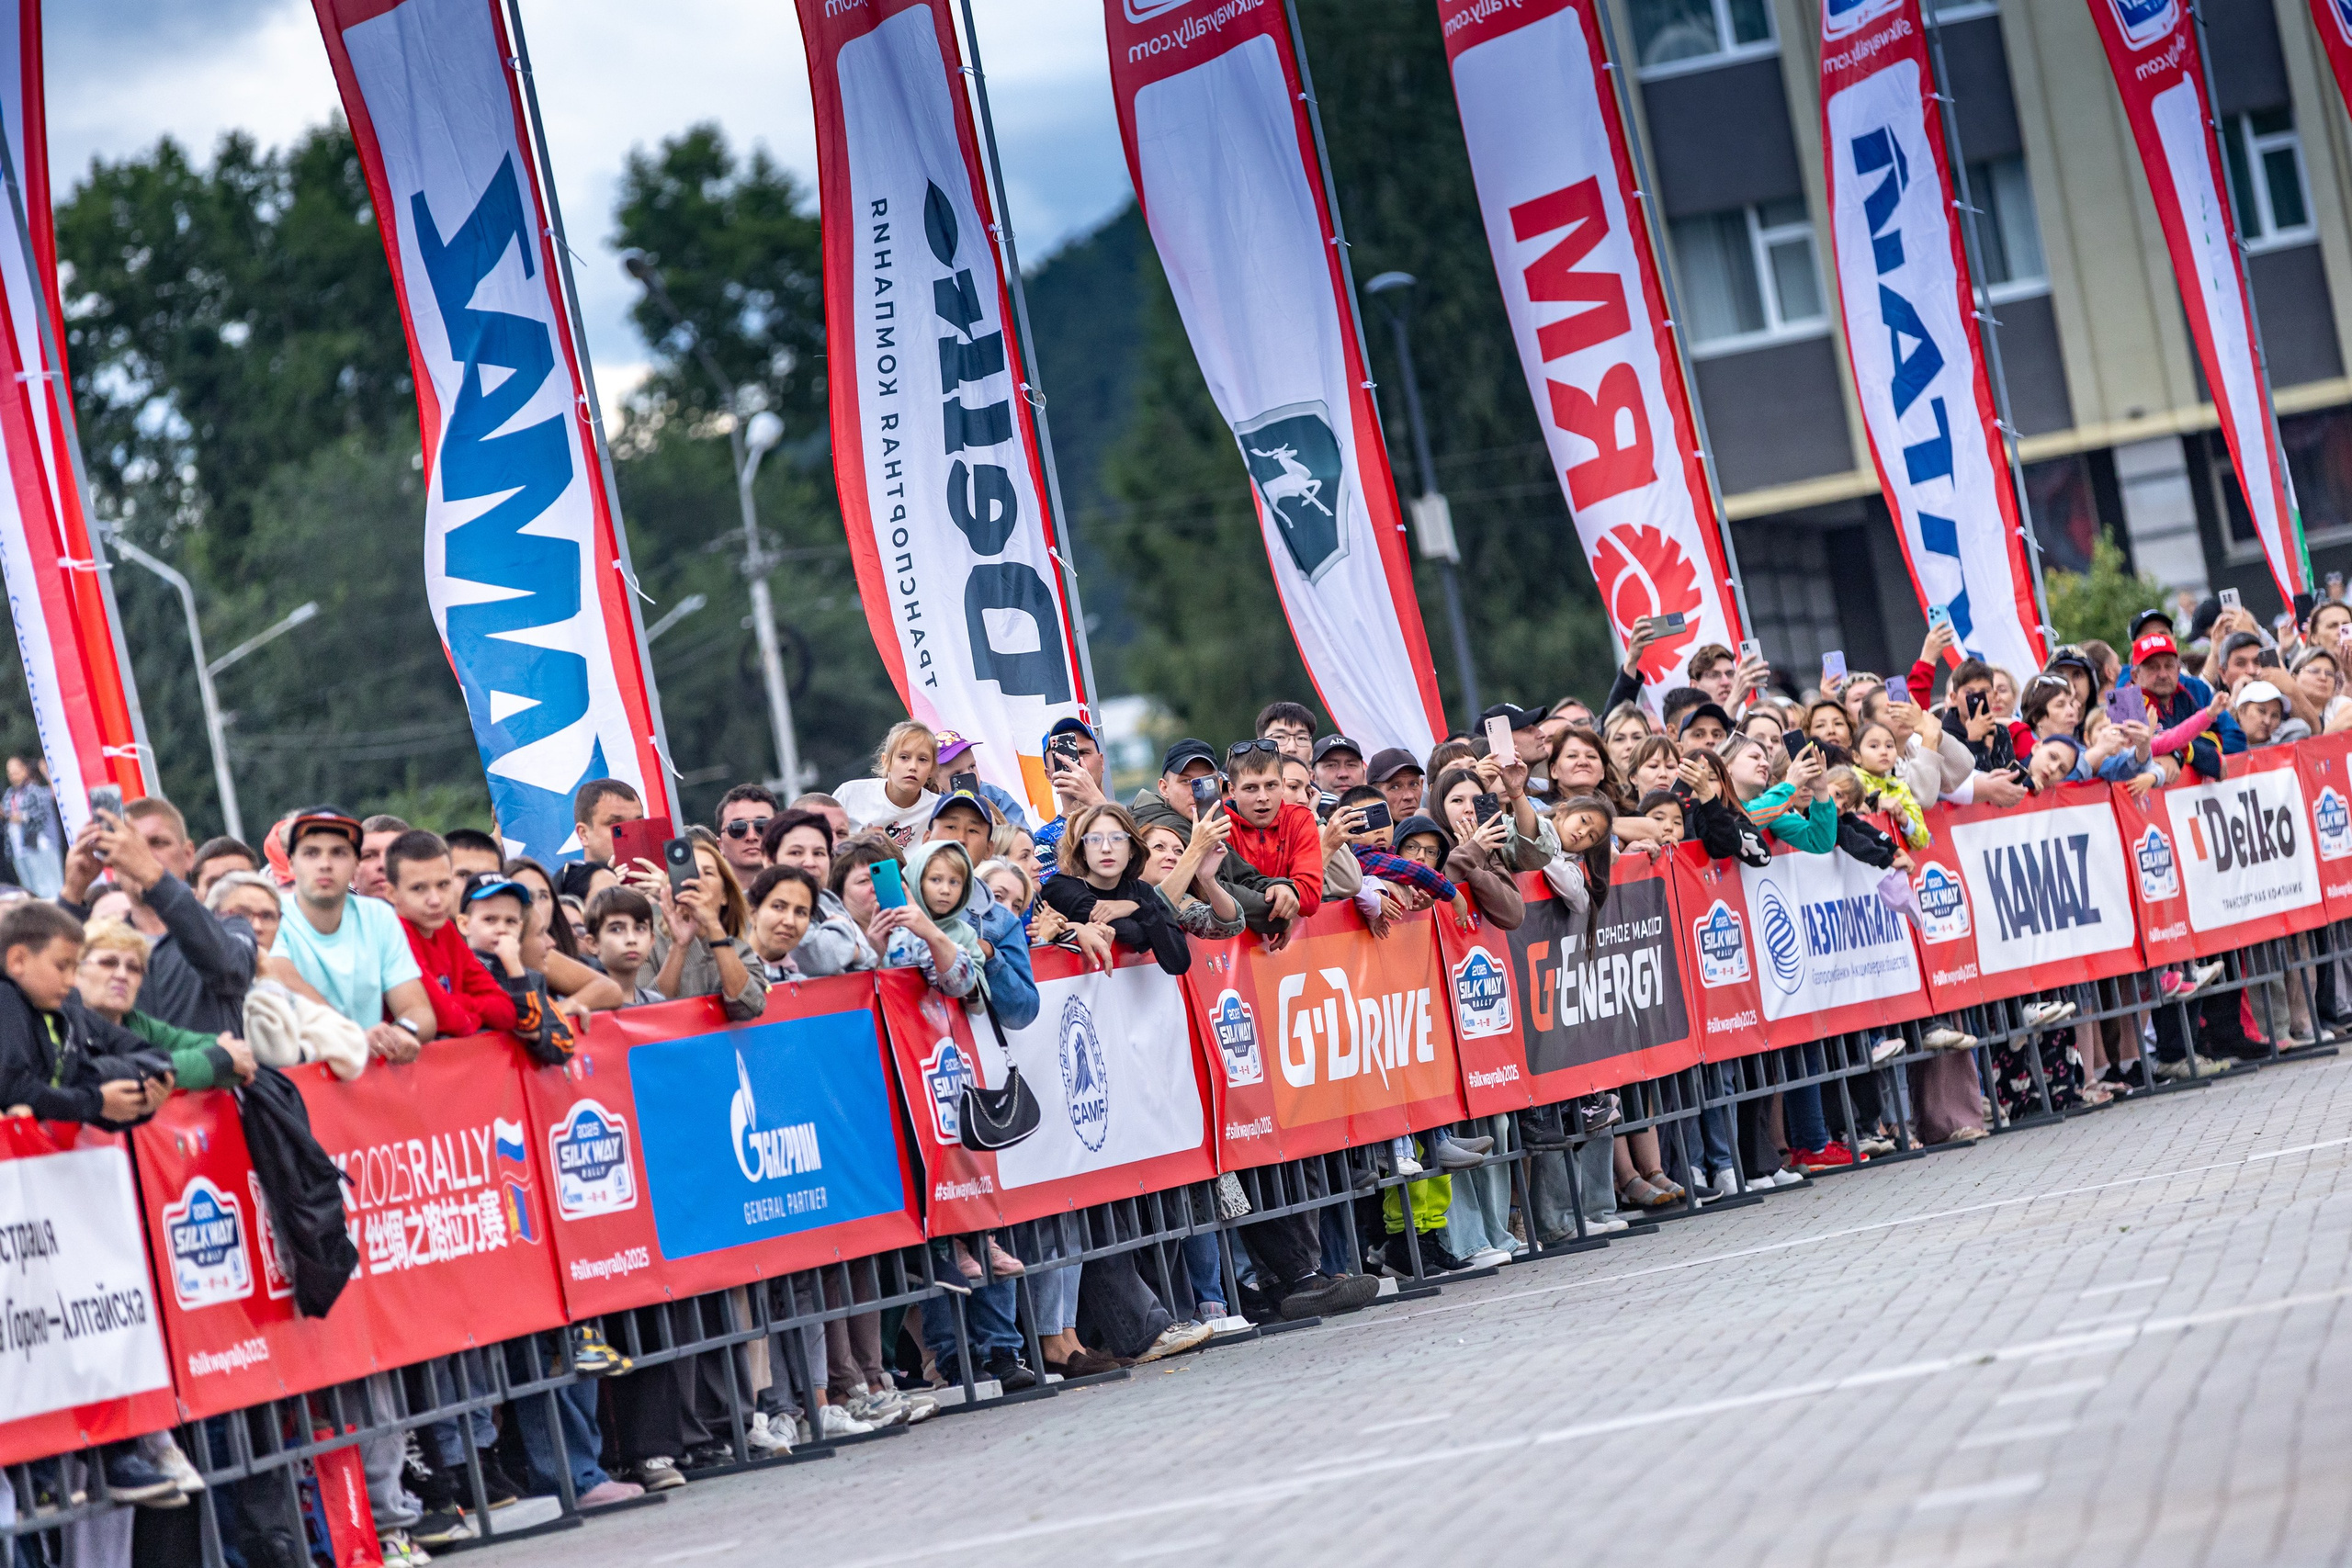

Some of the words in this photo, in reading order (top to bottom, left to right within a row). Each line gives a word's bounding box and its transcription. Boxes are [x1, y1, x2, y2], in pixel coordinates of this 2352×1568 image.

[1983, 833, 2101, 942] KAMAZ
[1580, 923, 1631, 952] МОРНОЕ
[1703, 931, 1725, 951] SILK
[1472, 964, 1487, 976] 2025
[1458, 978, 1484, 1000] SILK
[1483, 976, 1503, 997] WAY
[1472, 998, 1493, 1008] RALLY
[1219, 1024, 1239, 1045] SILK
[1238, 1021, 1252, 1043] WAY
[1468, 1063, 1520, 1089] #silkwayrally2025
[576, 1122, 601, 1139] 2025
[560, 1141, 593, 1169] SILK
[592, 1136, 620, 1163] WAY
[762, 1121, 822, 1180] GAZPROM
[581, 1166, 605, 1179] RALLY
[743, 1196, 786, 1225] GENERAL
[786, 1186, 829, 1215] PARTNER
[174, 1223, 210, 1255] SILK
[207, 1216, 234, 1247] WAY
[570, 1246, 650, 1281] #silkwayrally2025
[187, 1337, 270, 1378] #silkwayrally2025
